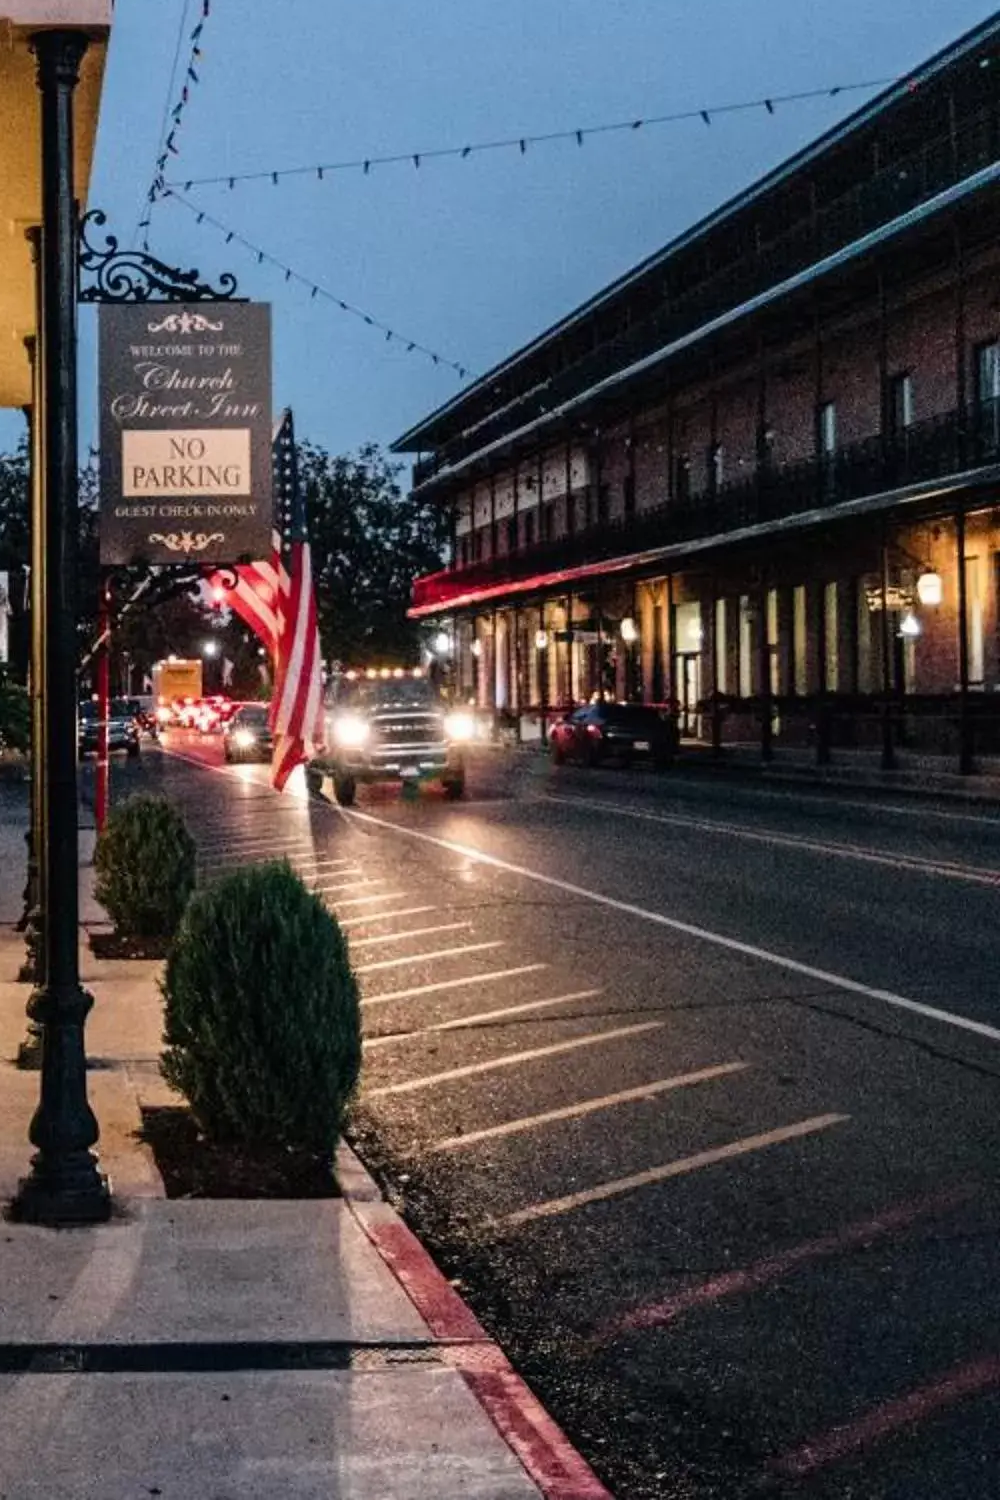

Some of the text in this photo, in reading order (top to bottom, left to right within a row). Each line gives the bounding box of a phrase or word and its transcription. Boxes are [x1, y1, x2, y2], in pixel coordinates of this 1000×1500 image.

[130, 344, 242, 357] WELCOME TO THE
[133, 361, 234, 390] Church
[111, 390, 263, 418] Street Inn
[169, 438, 205, 460] NO
[132, 465, 241, 489] PARKING
[115, 505, 157, 517] GUEST
[223, 503, 257, 517] ONLY
